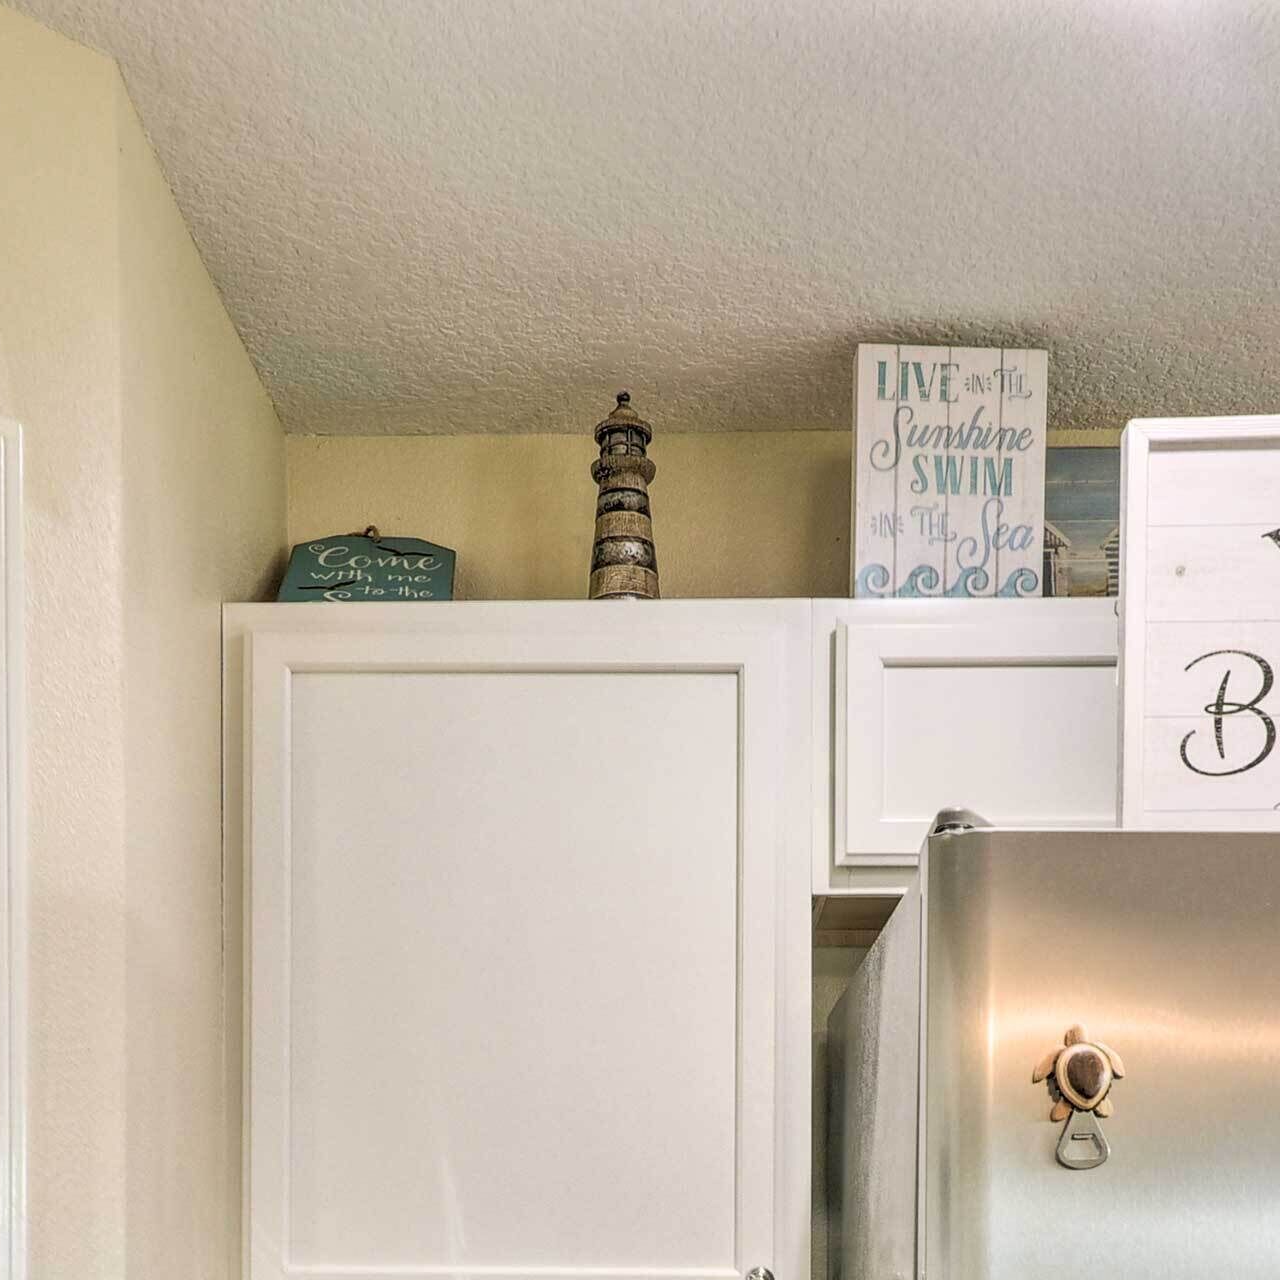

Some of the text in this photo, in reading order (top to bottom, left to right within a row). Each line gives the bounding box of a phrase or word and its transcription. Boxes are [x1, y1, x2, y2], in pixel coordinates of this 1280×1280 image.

[876, 360, 1033, 402] LIVE IN THE
[870, 405, 1034, 472] Sunshine
[910, 454, 1014, 497] SWIM
[878, 497, 1034, 572] IN THE Sea
[308, 543, 443, 571] Come
[310, 569, 432, 582] with me
[356, 585, 386, 596] to
[389, 585, 433, 599] the
